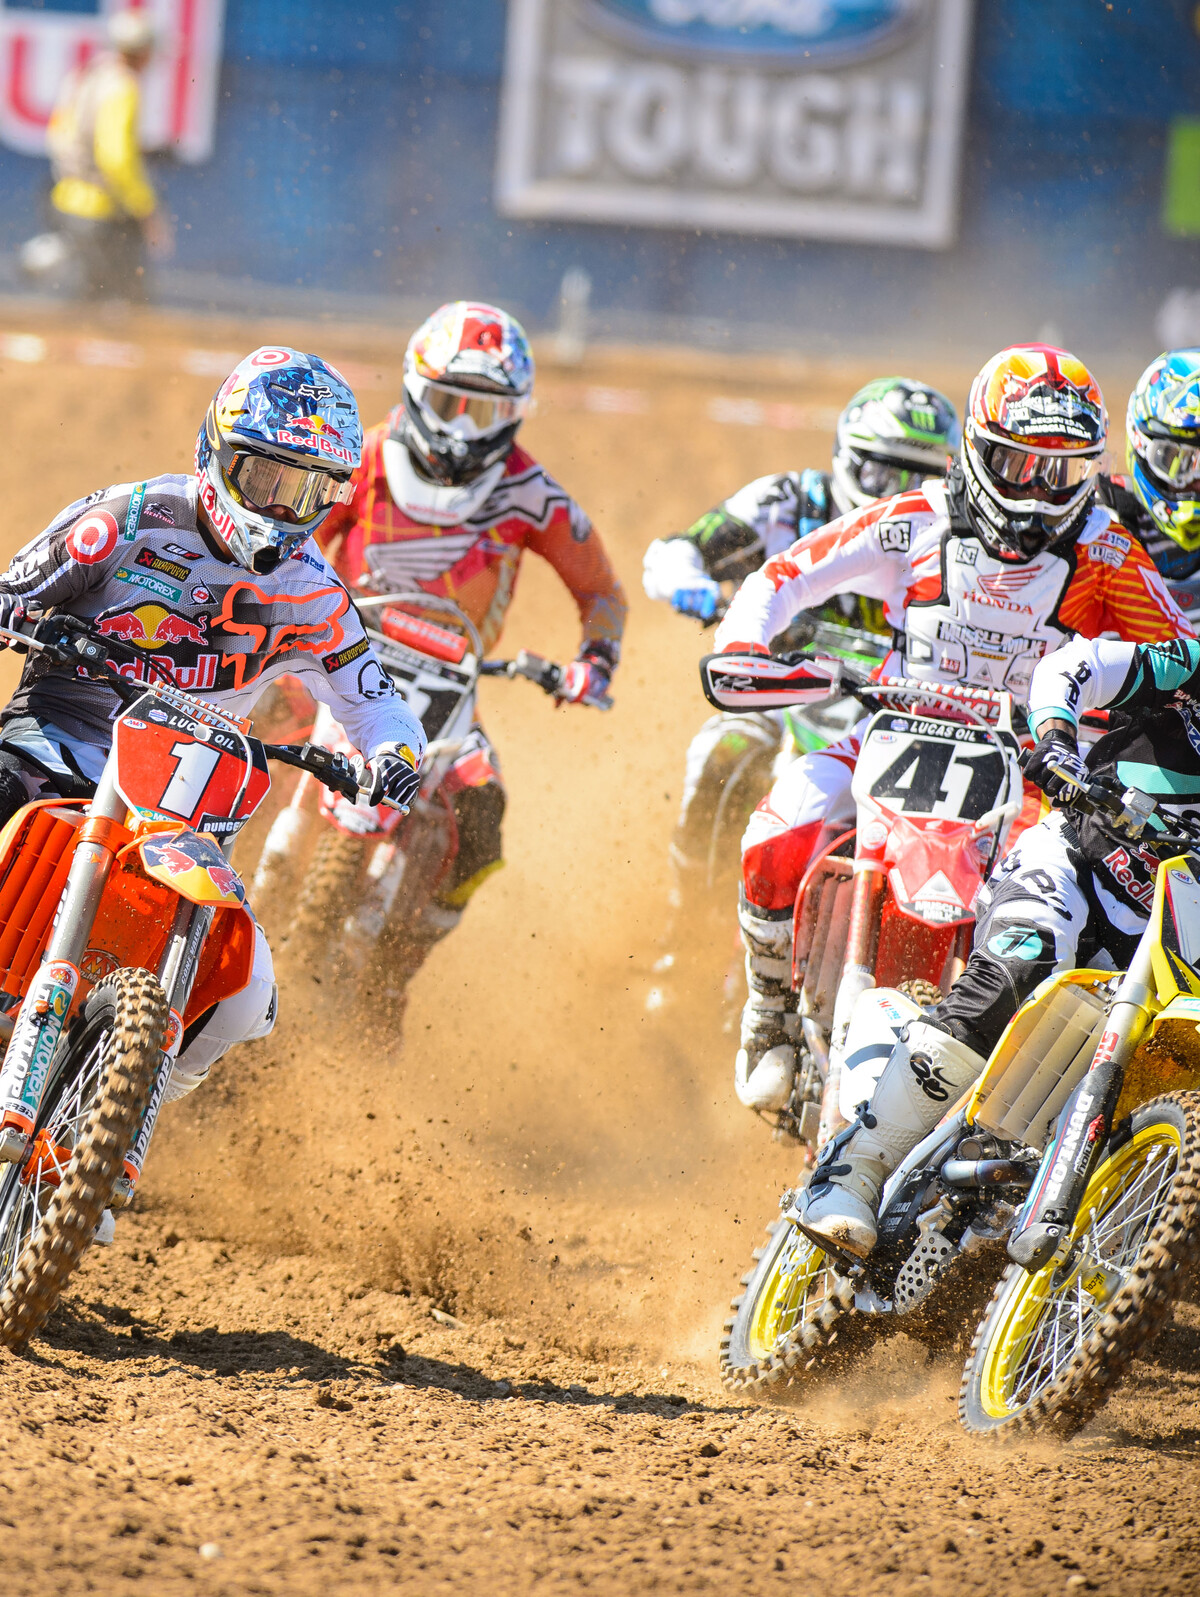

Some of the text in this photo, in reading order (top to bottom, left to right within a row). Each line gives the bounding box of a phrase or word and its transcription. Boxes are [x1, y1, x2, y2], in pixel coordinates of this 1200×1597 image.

[551, 57, 925, 197] TOUGH
[277, 429, 354, 464] Red Bull
[126, 494, 143, 536] MOTOREX
[127, 573, 178, 599] MOTOREX
[962, 589, 1034, 616] HONDA
[76, 652, 219, 690] ed Bull
[168, 715, 235, 751] LUCS OIL
[909, 720, 977, 742] LUCAS OIL
[168, 739, 224, 822] 1
[868, 737, 1012, 821] 41
[1102, 845, 1154, 900] Red
[25, 1013, 62, 1101] MOTOREX
[135, 1054, 172, 1157] DUNLOP
[1047, 1090, 1095, 1202] DUNLOP
